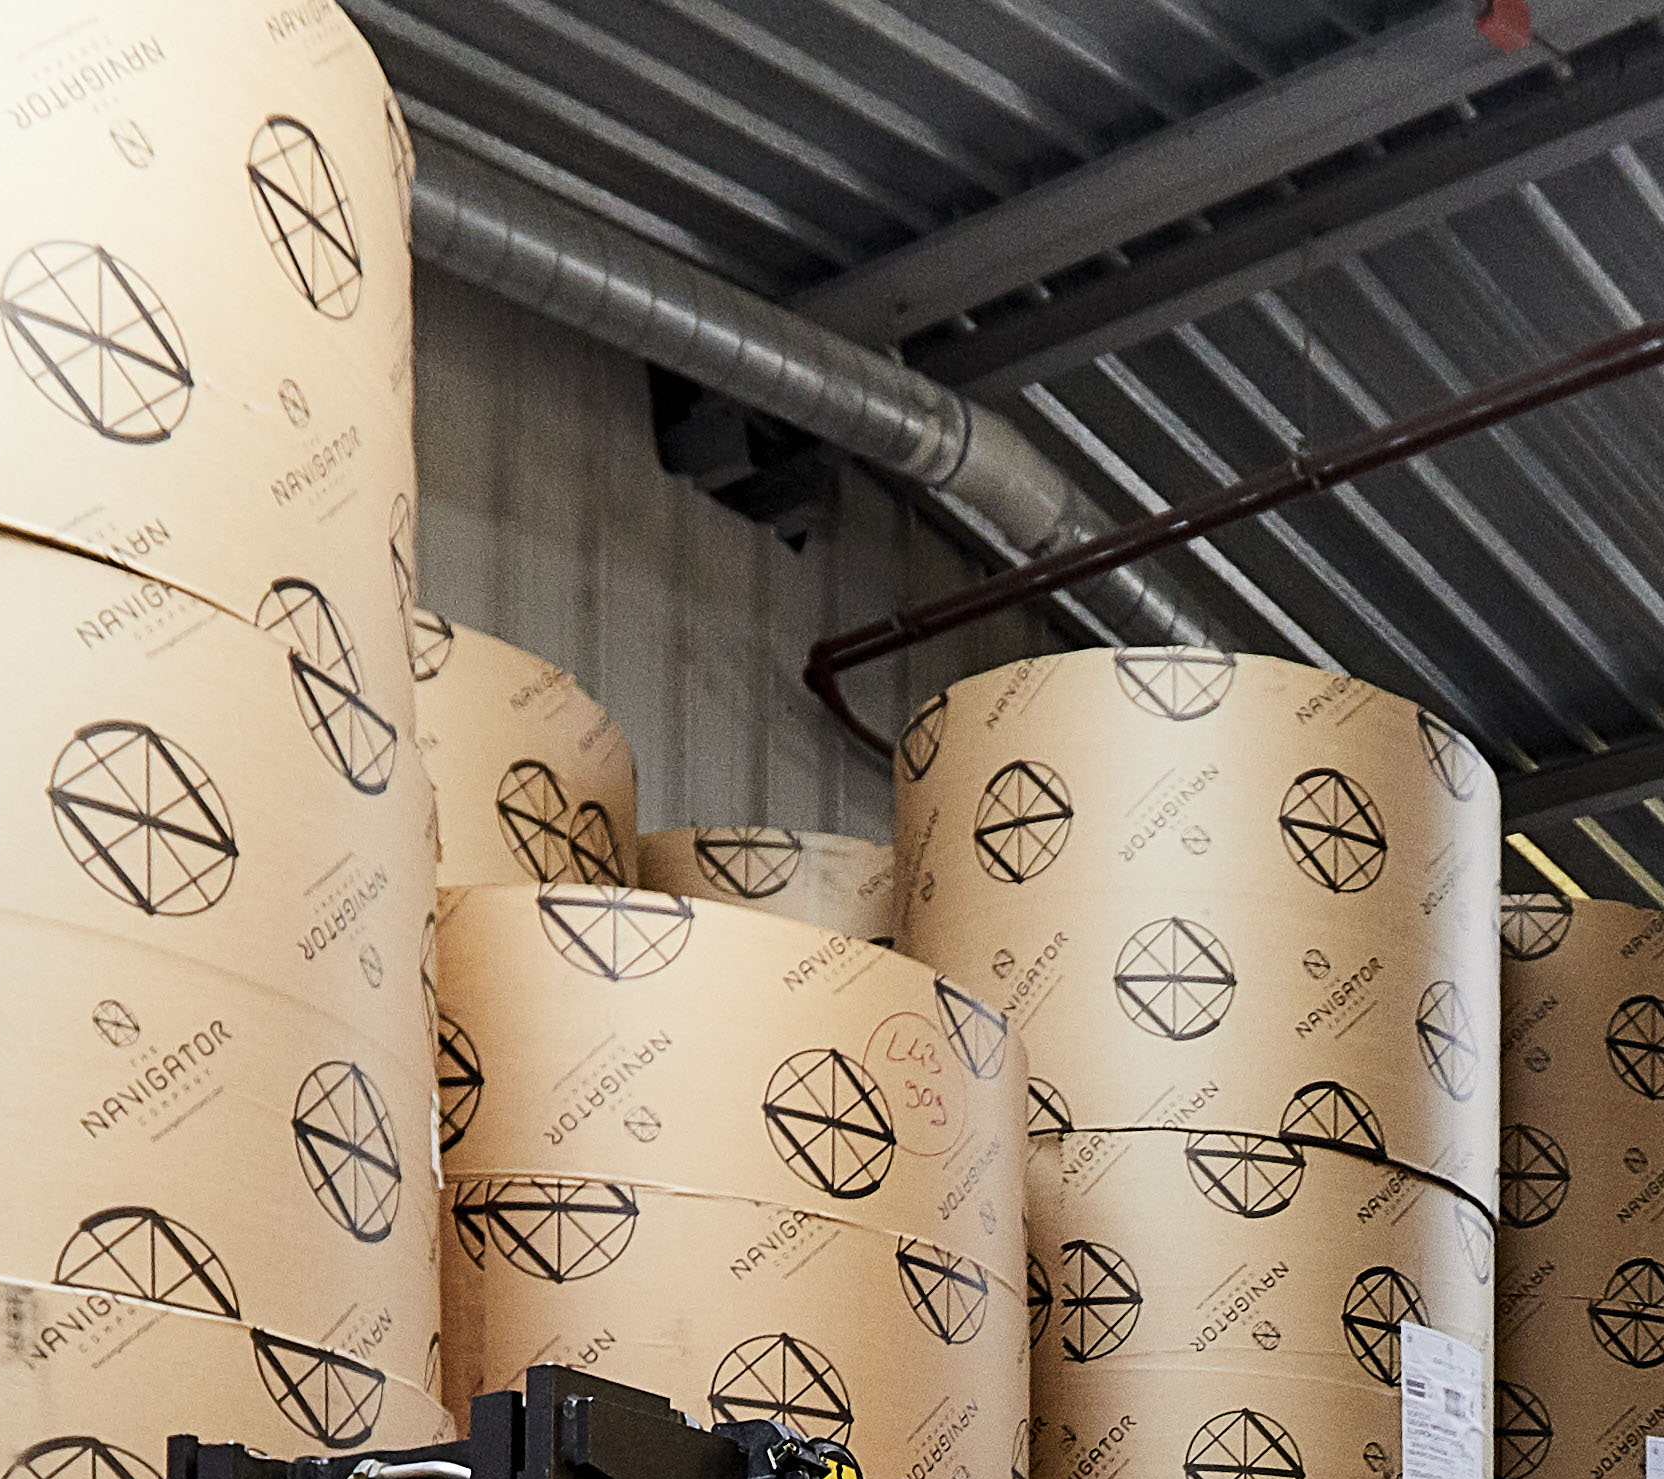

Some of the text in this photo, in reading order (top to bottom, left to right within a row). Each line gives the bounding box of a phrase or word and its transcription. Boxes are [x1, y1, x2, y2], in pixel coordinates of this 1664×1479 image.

[1120, 764, 1220, 862] NAVIGATOR
[1295, 958, 1384, 1040] NAVIGATOR
[79, 1018, 232, 1139] NAVIGATOR
[542, 1030, 674, 1146] NAVIGATOR
[1194, 1260, 1289, 1354] NAVIGATOR
